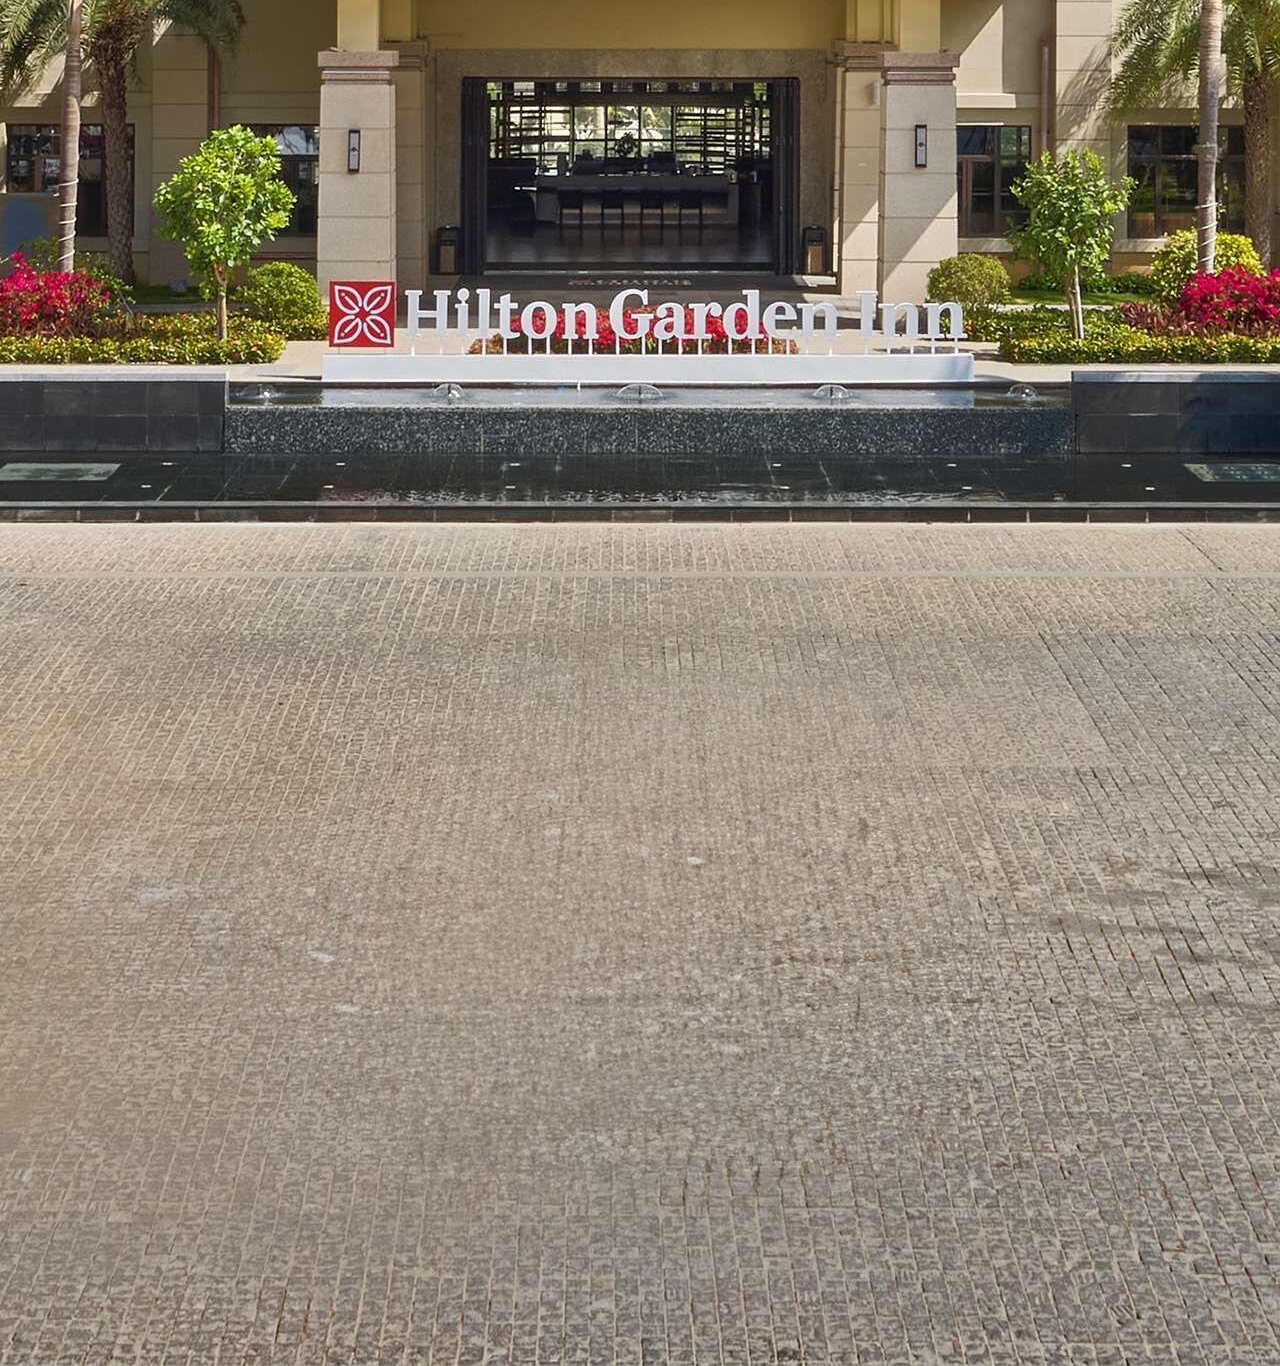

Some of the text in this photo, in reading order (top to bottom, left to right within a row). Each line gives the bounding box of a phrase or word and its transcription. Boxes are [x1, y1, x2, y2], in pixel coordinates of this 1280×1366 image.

[405, 288, 968, 340] Hilton Garden Inn
